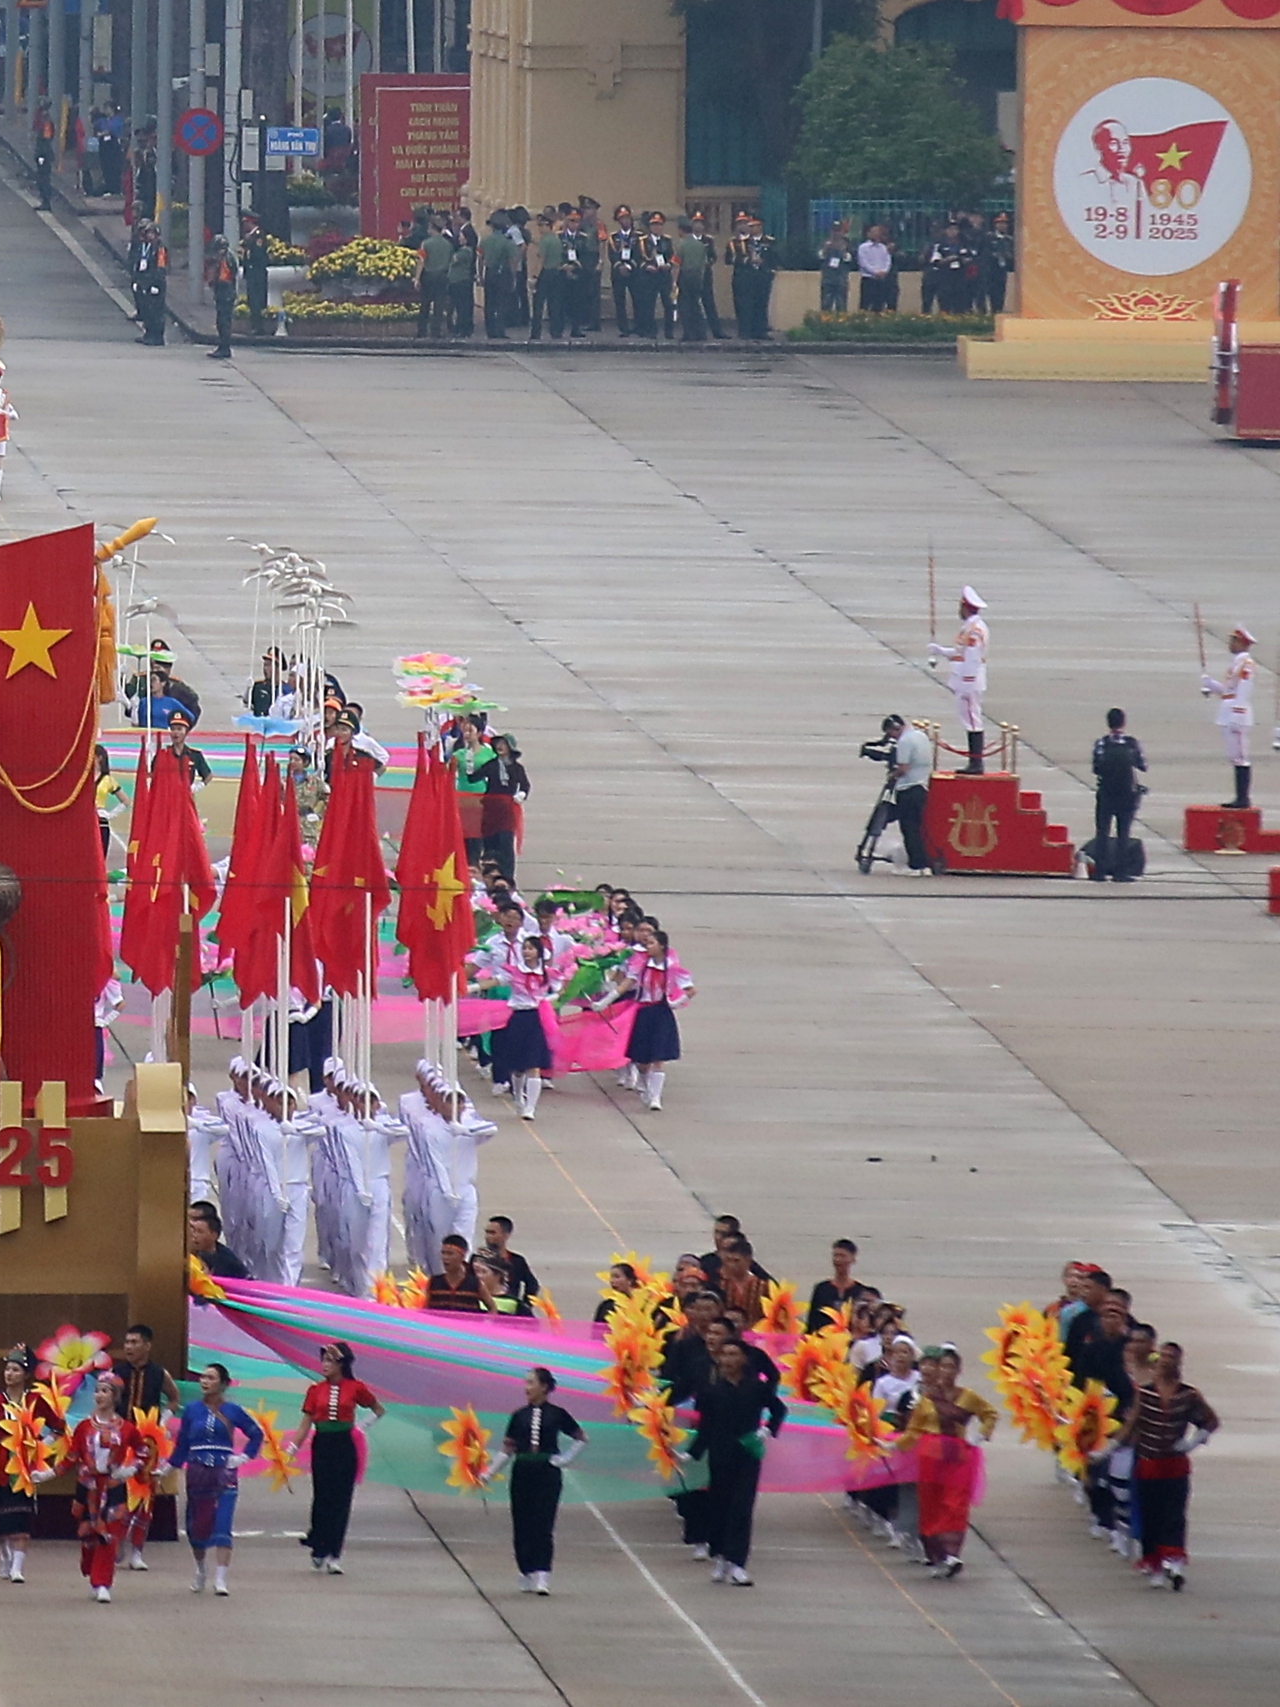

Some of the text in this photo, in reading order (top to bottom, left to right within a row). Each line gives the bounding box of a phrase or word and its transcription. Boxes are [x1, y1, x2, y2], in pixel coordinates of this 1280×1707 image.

[1150, 178, 1202, 210] 80
[1084, 206, 1128, 222] 19-8
[1149, 213, 1198, 226] 1945
[1094, 224, 1128, 239] 2-9
[1148, 227, 1198, 240] 2025
